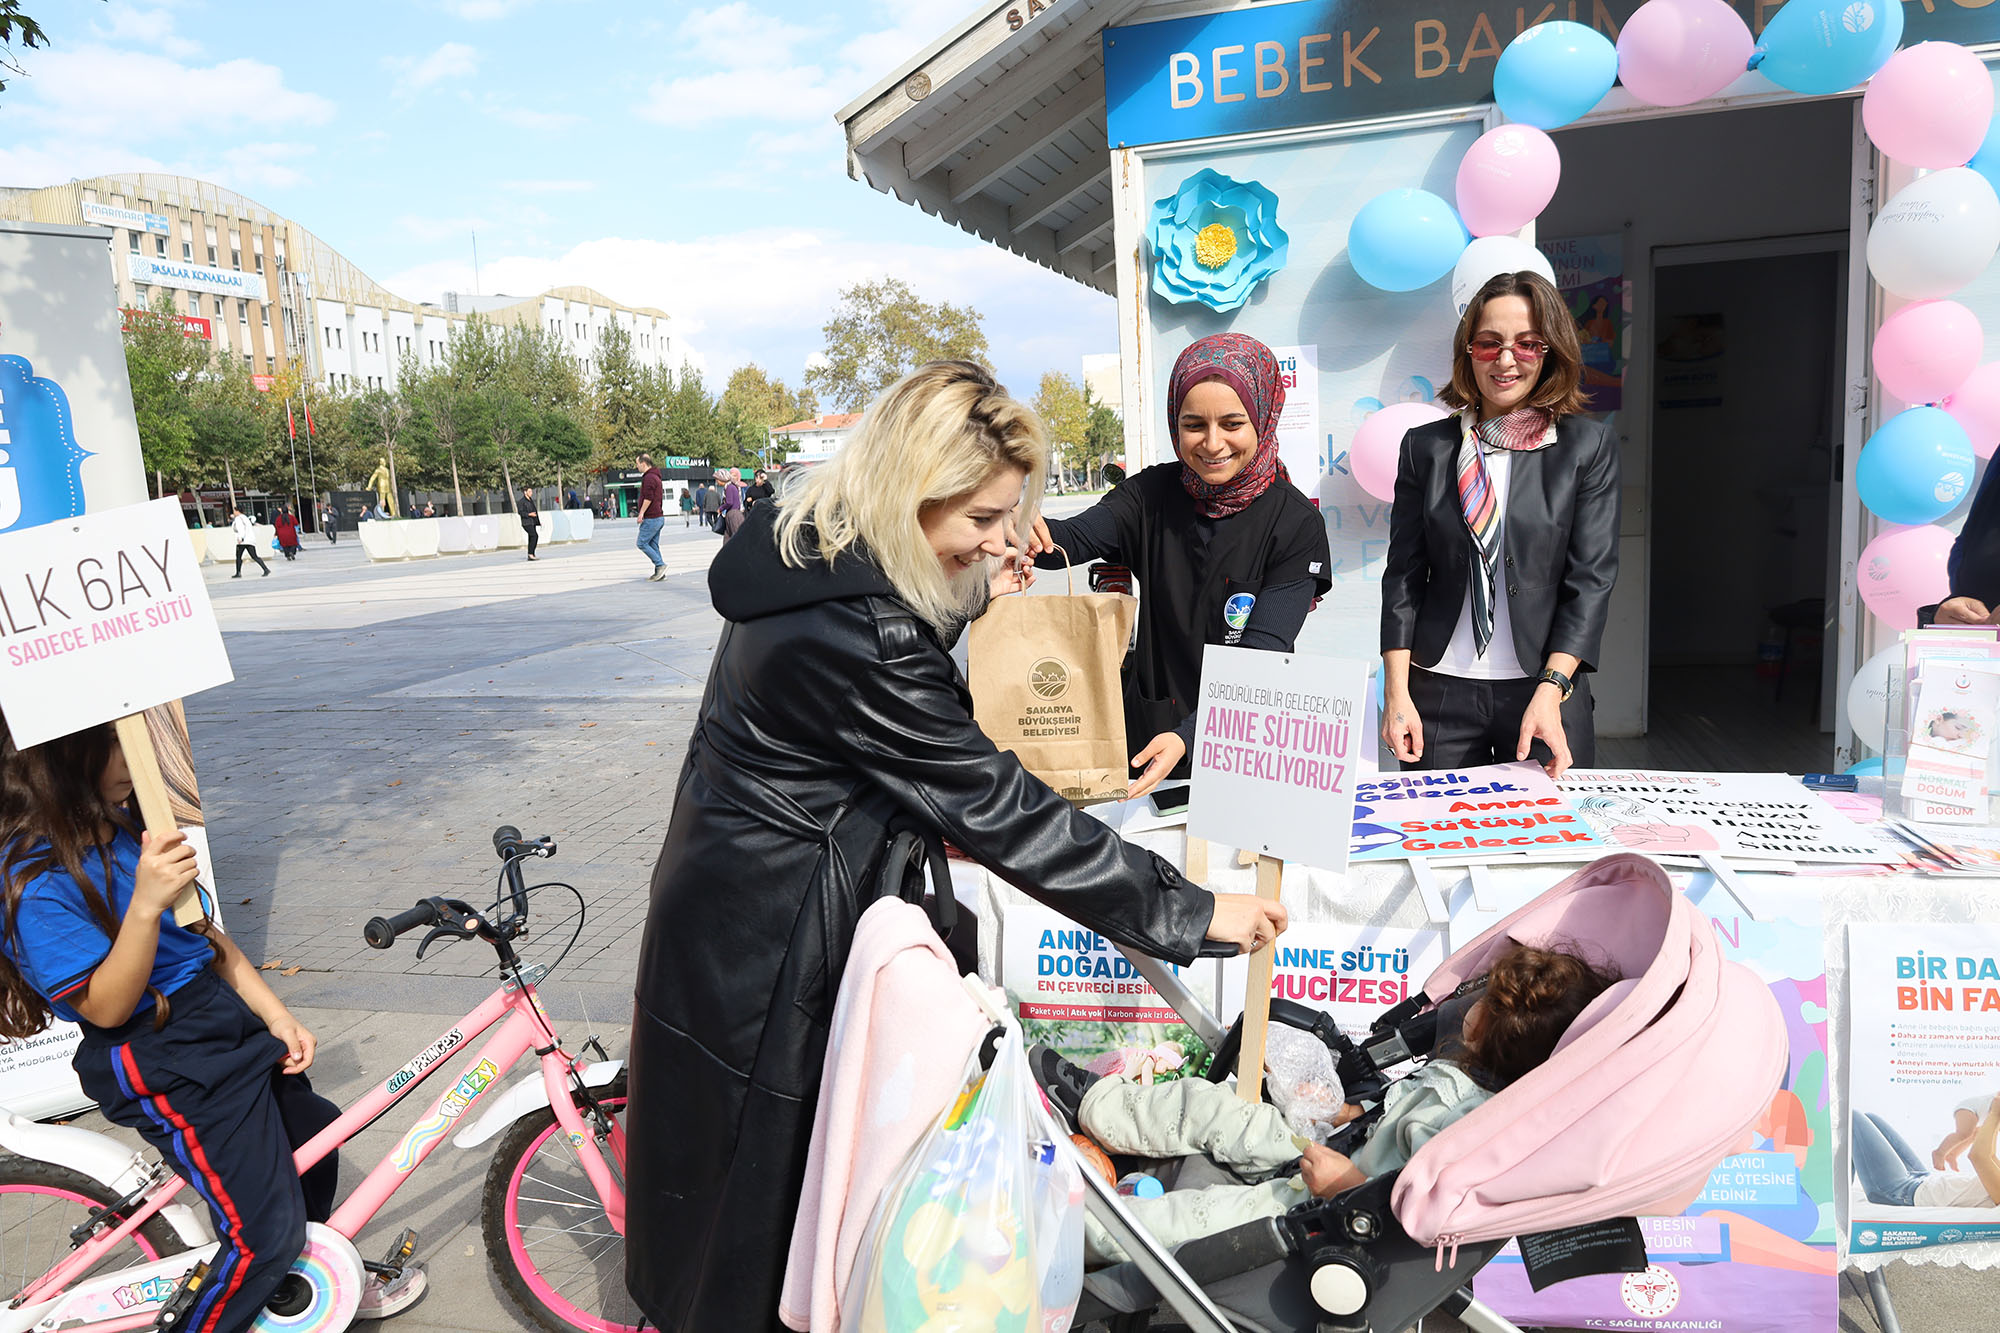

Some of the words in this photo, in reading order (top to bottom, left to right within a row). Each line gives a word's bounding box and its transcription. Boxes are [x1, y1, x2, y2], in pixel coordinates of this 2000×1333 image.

[1006, 0, 1056, 31] SA
[1169, 26, 1383, 110] BEBEK
[91, 206, 144, 223] MARMARA
[191, 269, 242, 287] KONAKLARI
[76, 538, 173, 612] 6AY
[7, 626, 89, 667] SADECE
[91, 611, 144, 645] ANNE
[147, 594, 194, 628] SÜTÜ
[1207, 681, 1284, 708] SÜRDÜRÜLEBİLİR
[1284, 692, 1330, 715] GELECEK
[1331, 695, 1353, 718] İÇİN
[1025, 705, 1073, 715] SAKARYA
[1018, 715, 1081, 727] BÜYÜKŞEHİR
[1022, 725, 1080, 737] BELEDİYESİ
[1204, 705, 1259, 744] ANNE
[1262, 710, 1350, 759] SÜTÜNÜ
[1200, 741, 1346, 794] DESTEKLİYORUZ
[1356, 773, 1470, 792] ağlıklı
[1918, 773, 1968, 789] NORMAL
[1355, 781, 1529, 803] Gelecek,
[1916, 782, 1966, 800] DOĞUM
[1448, 797, 1562, 813] Anne
[1640, 796, 1814, 810] Vereceğiniz
[1665, 806, 1709, 816] En
[1926, 803, 1974, 817] DOĞUM
[1400, 812, 1577, 833] Sütüyle
[1711, 818, 1824, 831] Hediye
[1401, 829, 1594, 852] Gelecek
[1735, 830, 1822, 841] Anne
[1737, 841, 1878, 855] Sütüdür
[1038, 929, 1108, 952] ANNE
[1341, 945, 1409, 974] SÜTÜ
[1896, 949, 1948, 980] BİR
[1956, 956, 2000, 981] DA
[1038, 980, 1056, 992] EN
[1058, 980, 1115, 995] ÇEVRECİ
[1271, 970, 1409, 1005] MUCİZESİ
[1897, 979, 1954, 1011] BİN
[1962, 987, 2000, 1012] FA
[1030, 1006, 1051, 1016] Paket
[1051, 1008, 1066, 1016] yok
[1070, 1008, 1087, 1017] Atık
[1087, 1009, 1103, 1018] yok
[1107, 1009, 1134, 1018] Karbon
[1135, 1010, 1153, 1020] ayak
[25, 1030, 79, 1050] BAKANLIĞI
[18, 1048, 76, 1069] MÜDÜRLÜĞÜ
[1897, 1059, 1924, 1067] Anneyi
[1952, 1060, 1994, 1068] yumurtalık
[1896, 1077, 1941, 1085] Depresyonu
[1944, 1069, 1962, 1077] karşı
[442, 1063, 498, 1117] kidzy
[1712, 1173, 1731, 1185] VE
[1734, 1171, 1796, 1185] ÖTESİNE
[1711, 1187, 1758, 1201] EDİNİZ
[1653, 1217, 1697, 1232] BESİN
[1648, 1235, 1693, 1249] TÜDÜR
[1584, 1319, 1606, 1327] T.C.
[1608, 1317, 1652, 1329] SAĞLIK
[1654, 1318, 1723, 1330] BAKANLIĞI
